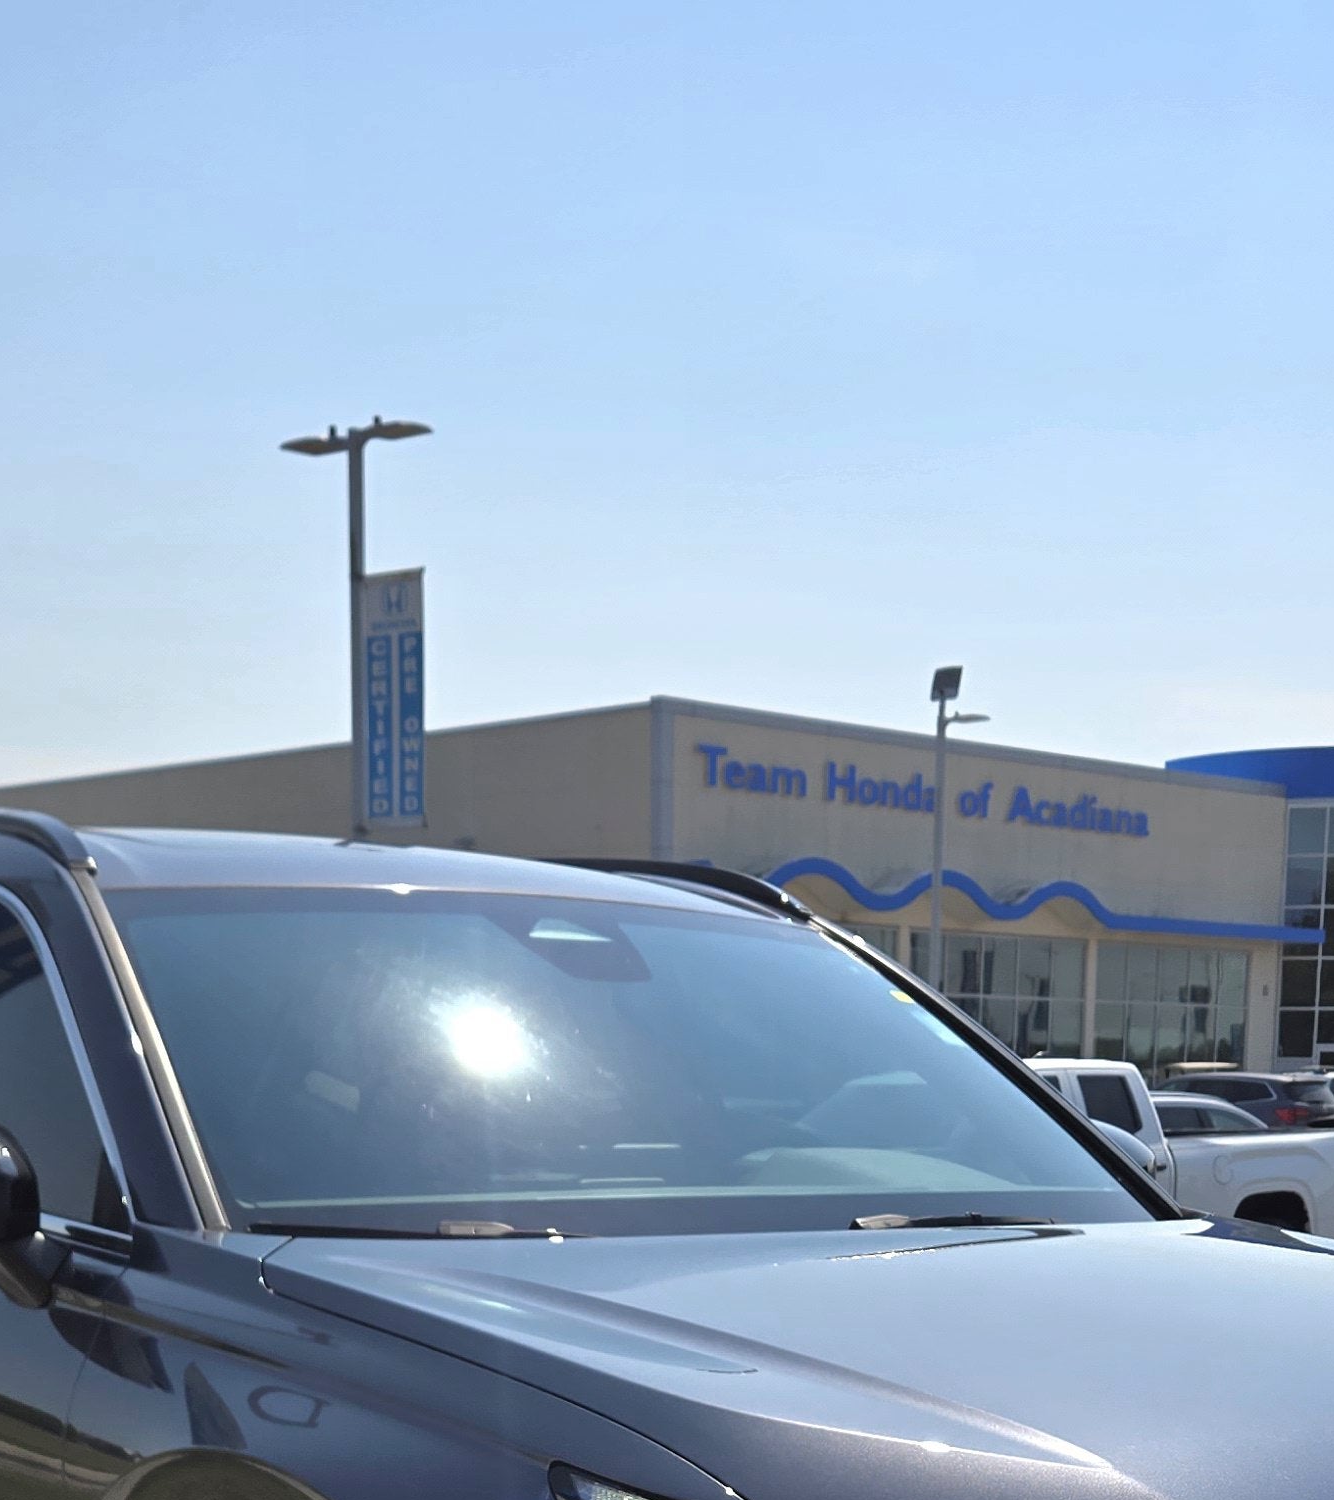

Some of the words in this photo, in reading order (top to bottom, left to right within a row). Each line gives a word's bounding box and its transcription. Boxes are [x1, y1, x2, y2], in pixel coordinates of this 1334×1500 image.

[695, 743, 808, 798] Team
[959, 780, 995, 819] of
[1007, 785, 1150, 837] Acadiana
